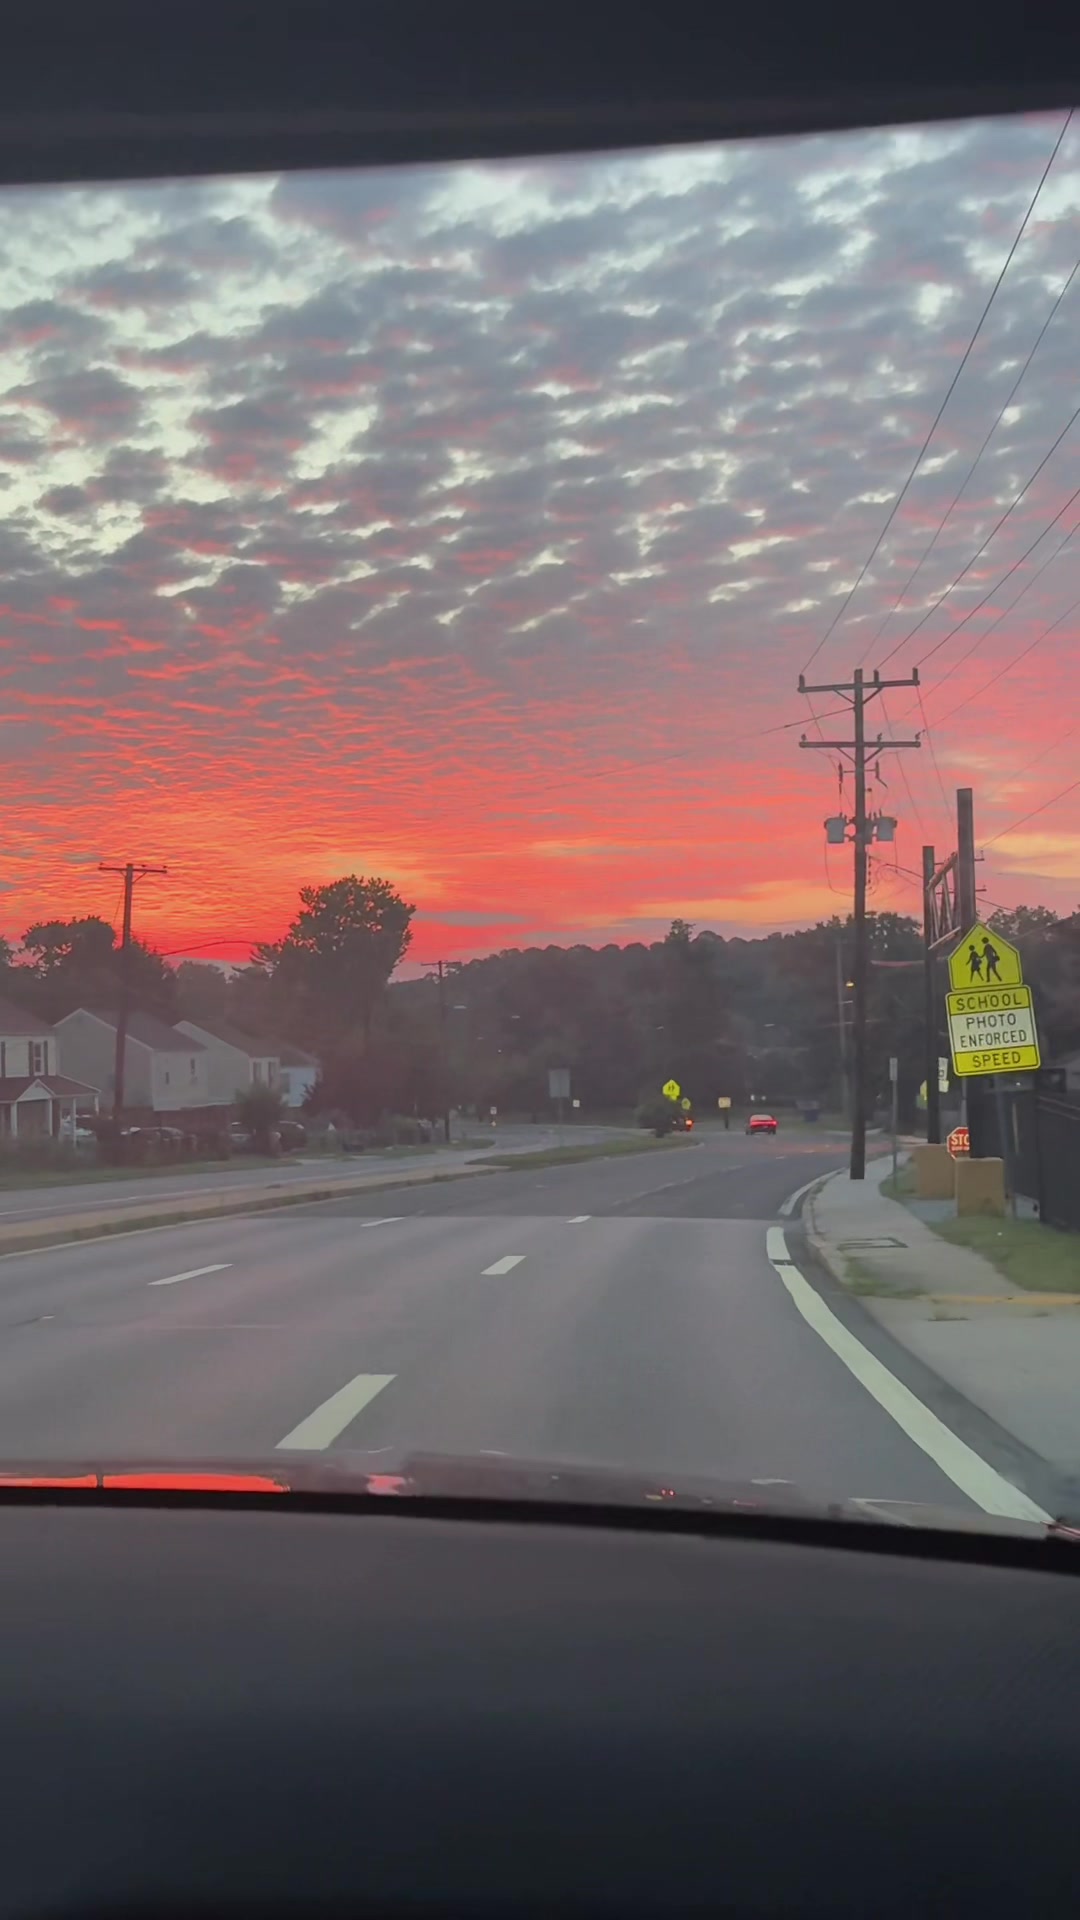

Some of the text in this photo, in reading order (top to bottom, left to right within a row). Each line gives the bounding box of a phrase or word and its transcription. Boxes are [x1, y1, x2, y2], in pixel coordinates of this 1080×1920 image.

[956, 993, 1022, 1011] SCHOOL
[966, 1013, 1016, 1030] PHOTO
[960, 1029, 1027, 1048] ENFORCED
[972, 1051, 1021, 1068] SPEED
[951, 1134, 969, 1145] STO
